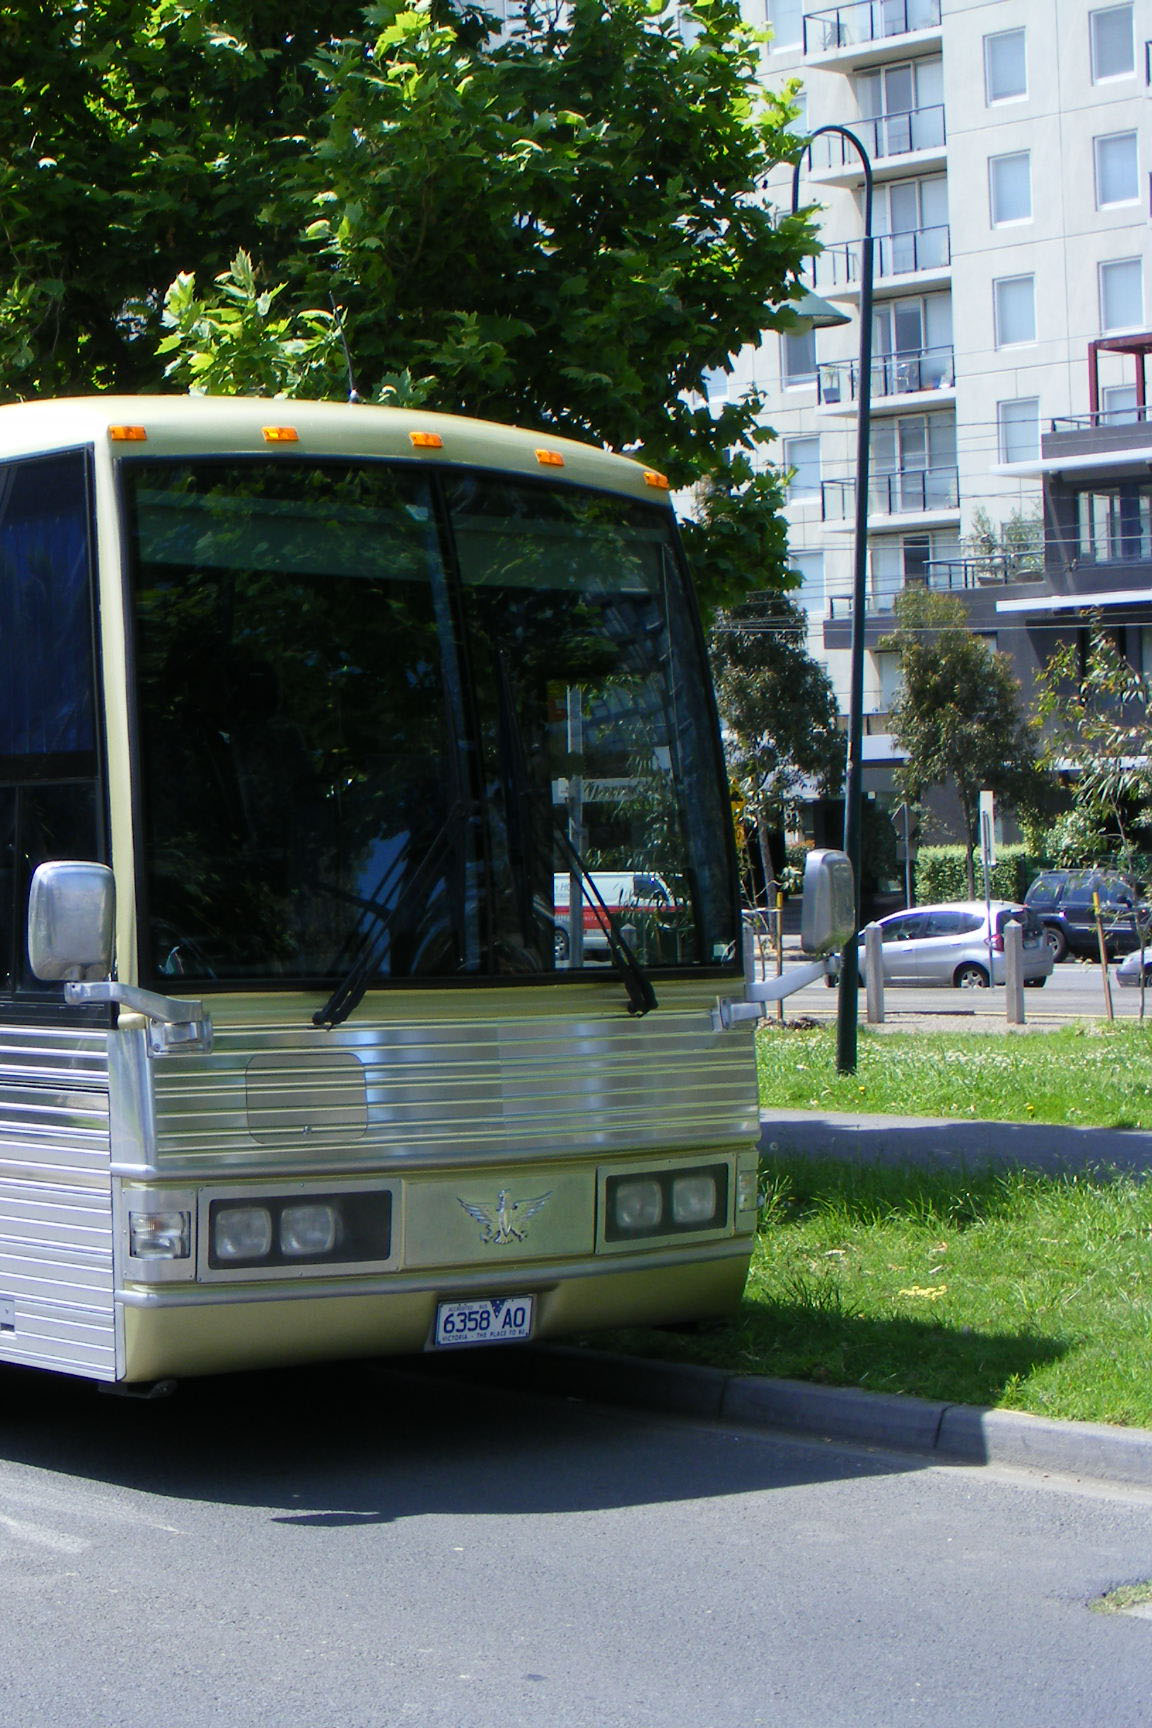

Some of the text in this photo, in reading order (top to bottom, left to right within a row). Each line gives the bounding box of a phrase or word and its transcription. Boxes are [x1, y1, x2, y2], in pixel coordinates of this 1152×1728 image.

[443, 1307, 526, 1334] 6358 AO
[442, 1334, 468, 1342] VICTORIA
